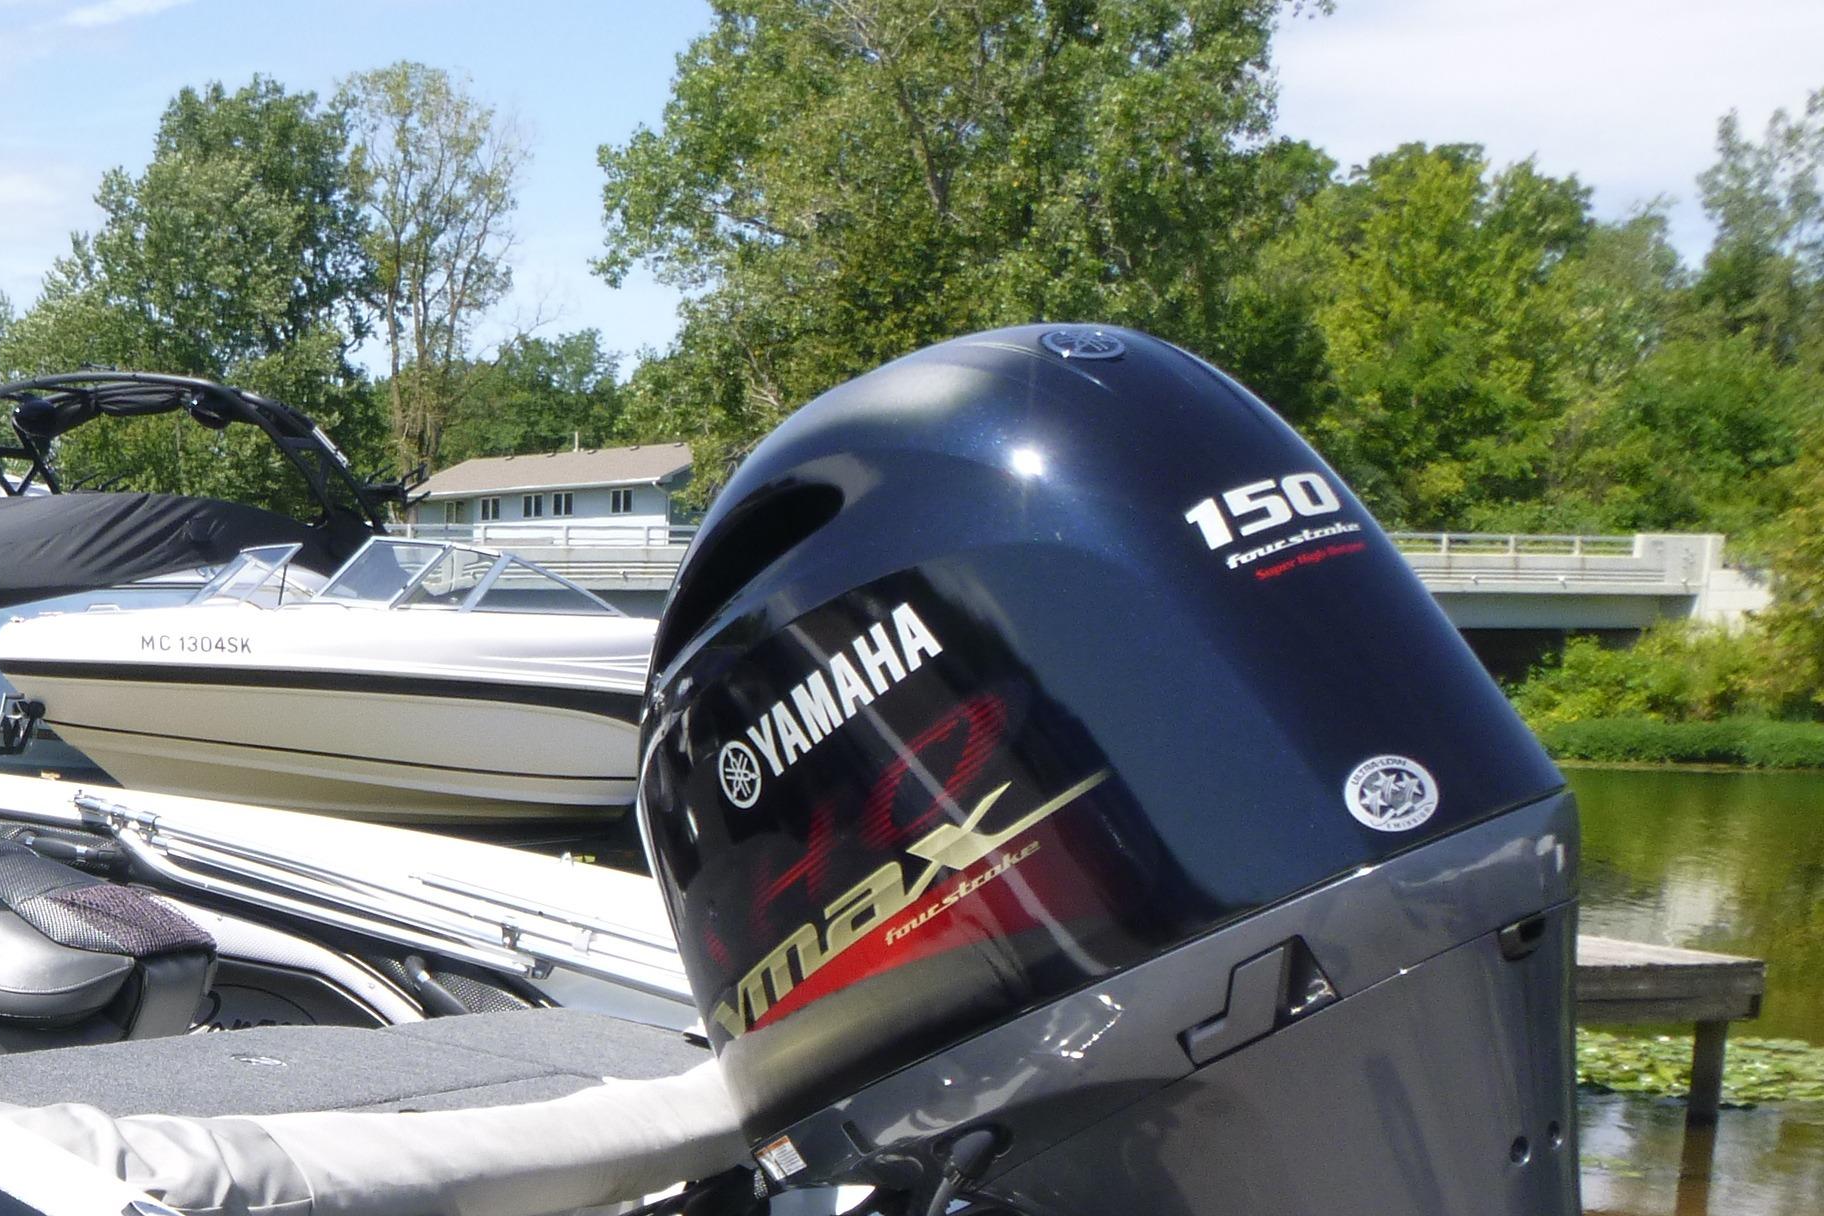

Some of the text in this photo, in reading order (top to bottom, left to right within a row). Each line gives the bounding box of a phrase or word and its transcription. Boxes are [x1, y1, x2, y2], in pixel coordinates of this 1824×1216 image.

[1184, 473, 1341, 550] 150
[179, 636, 252, 654] 1304SK
[746, 602, 944, 777] YAMAHA
